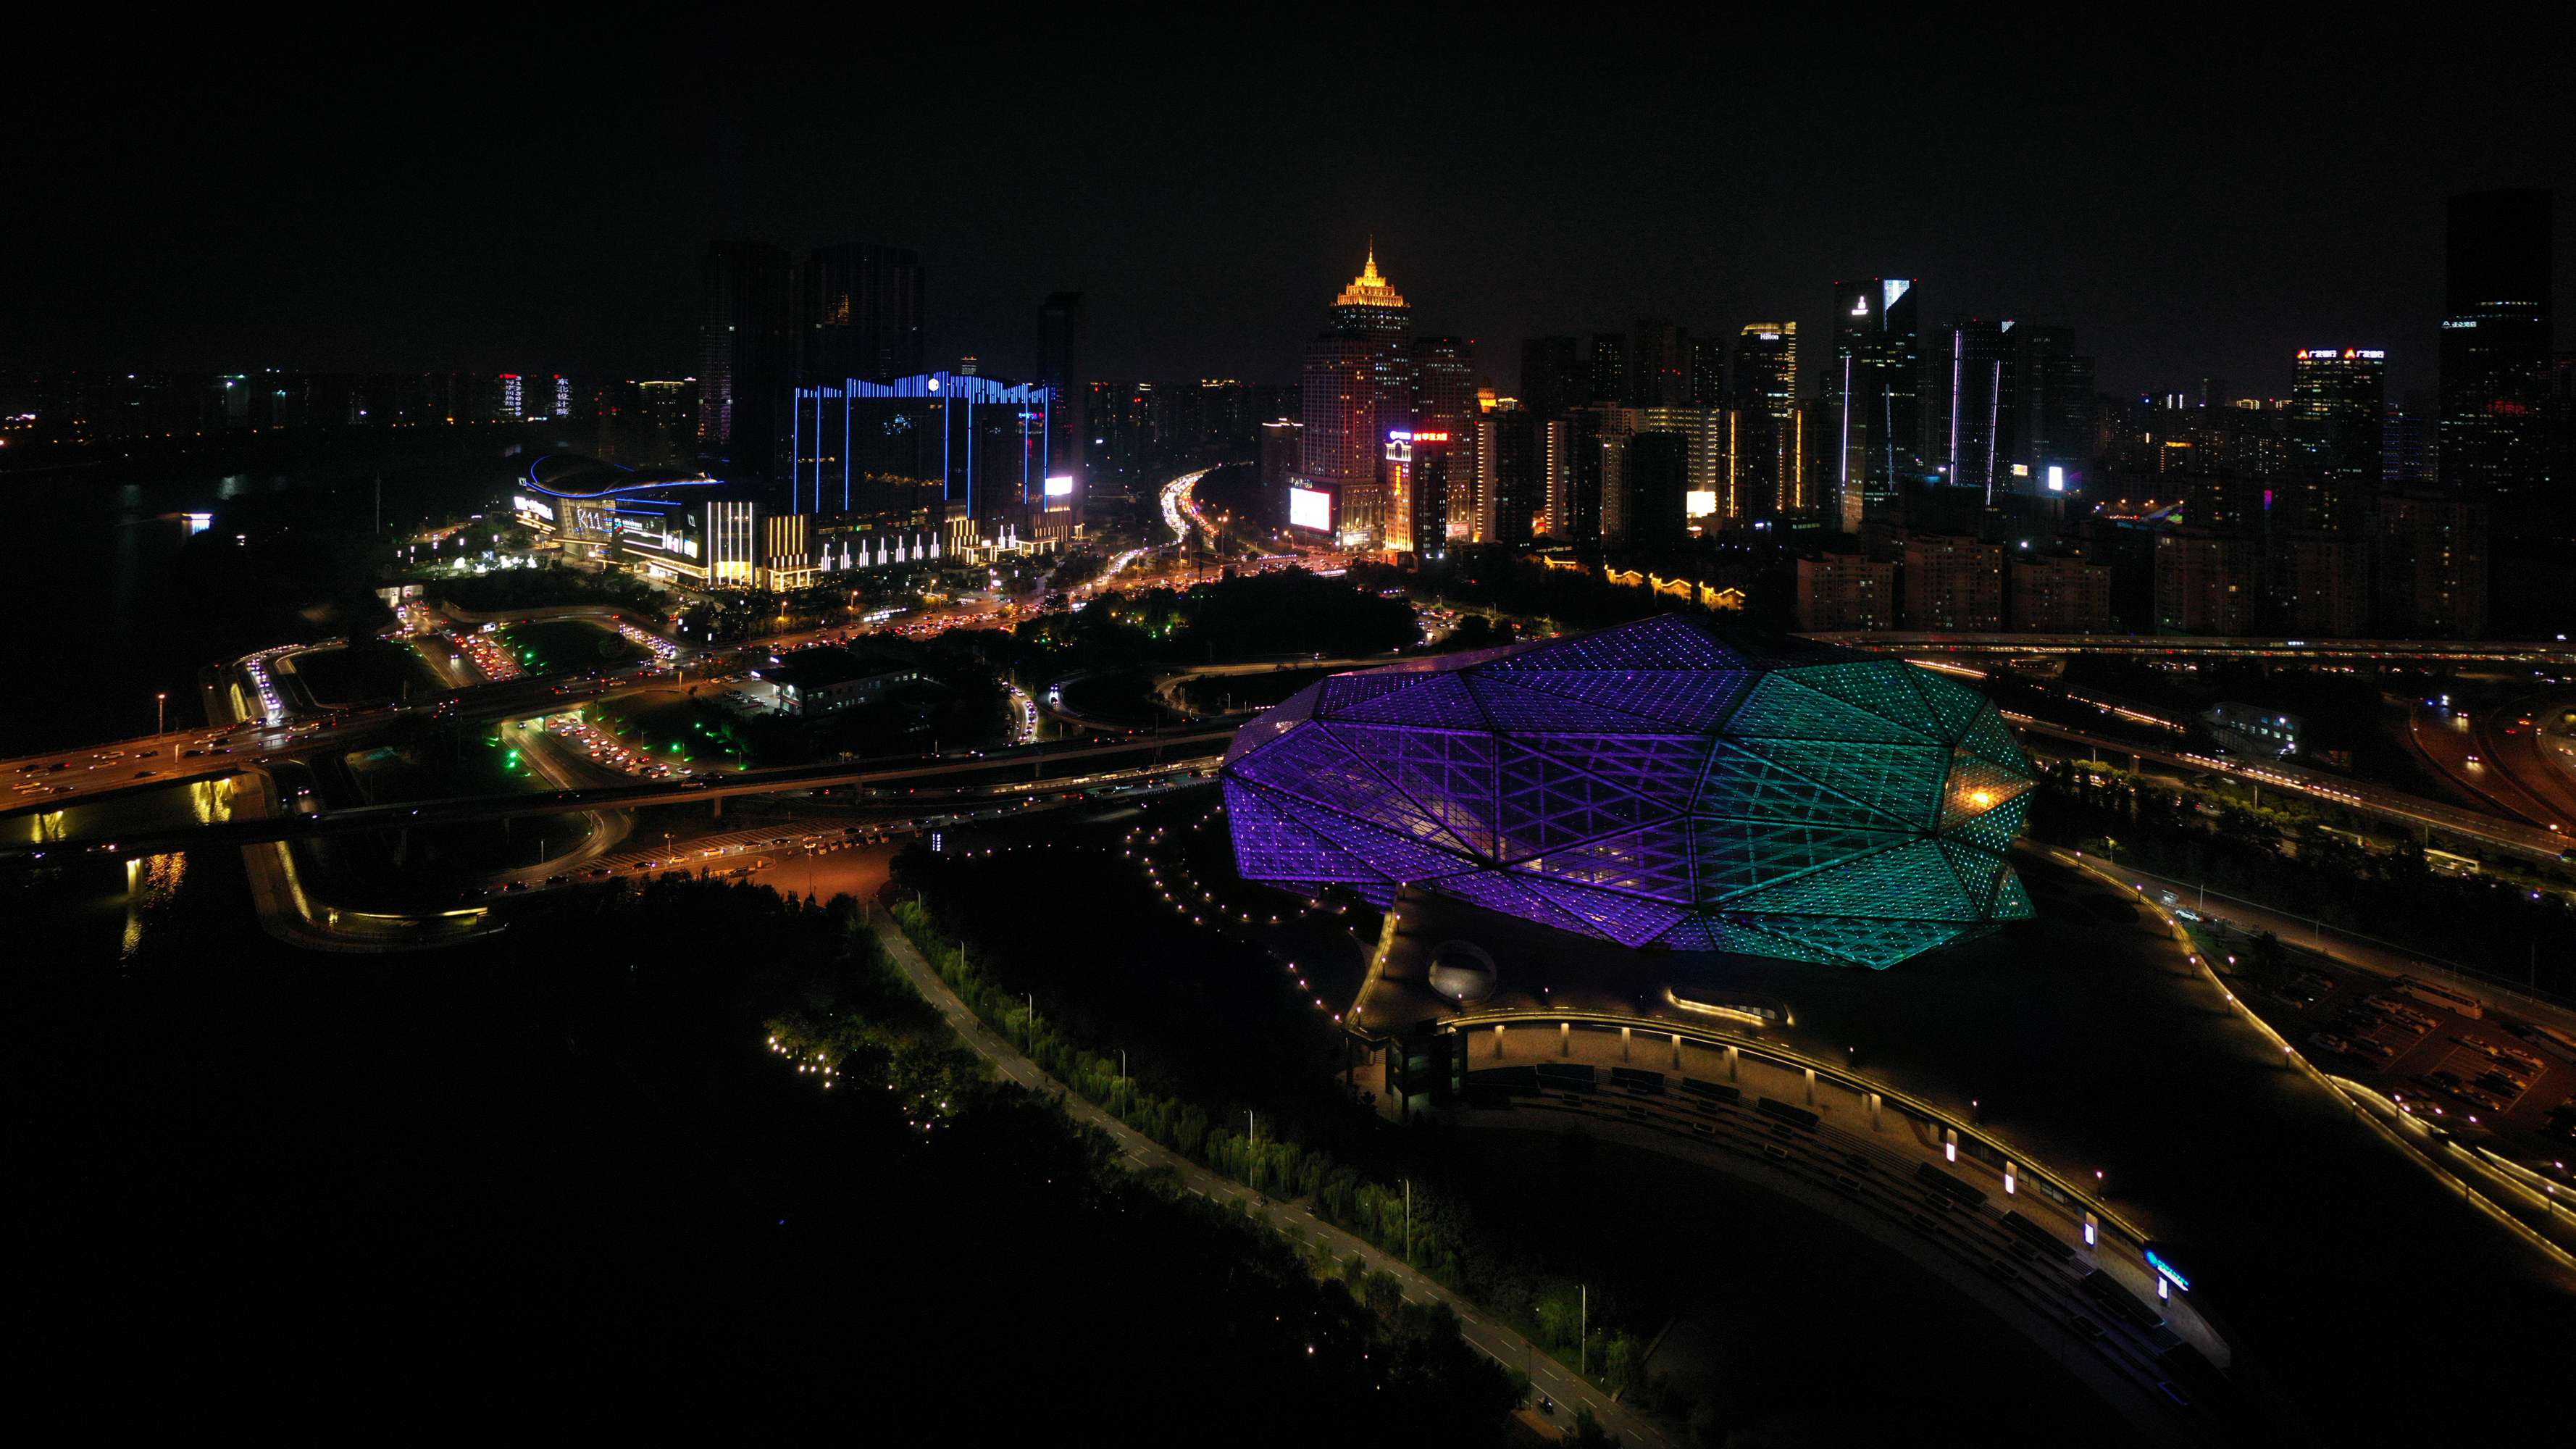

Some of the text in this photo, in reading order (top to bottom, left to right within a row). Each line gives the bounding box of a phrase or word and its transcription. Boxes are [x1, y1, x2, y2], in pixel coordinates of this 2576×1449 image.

[556, 378, 569, 415] 东北设计院
[518, 477, 527, 487] K11
[577, 509, 602, 530] K11
